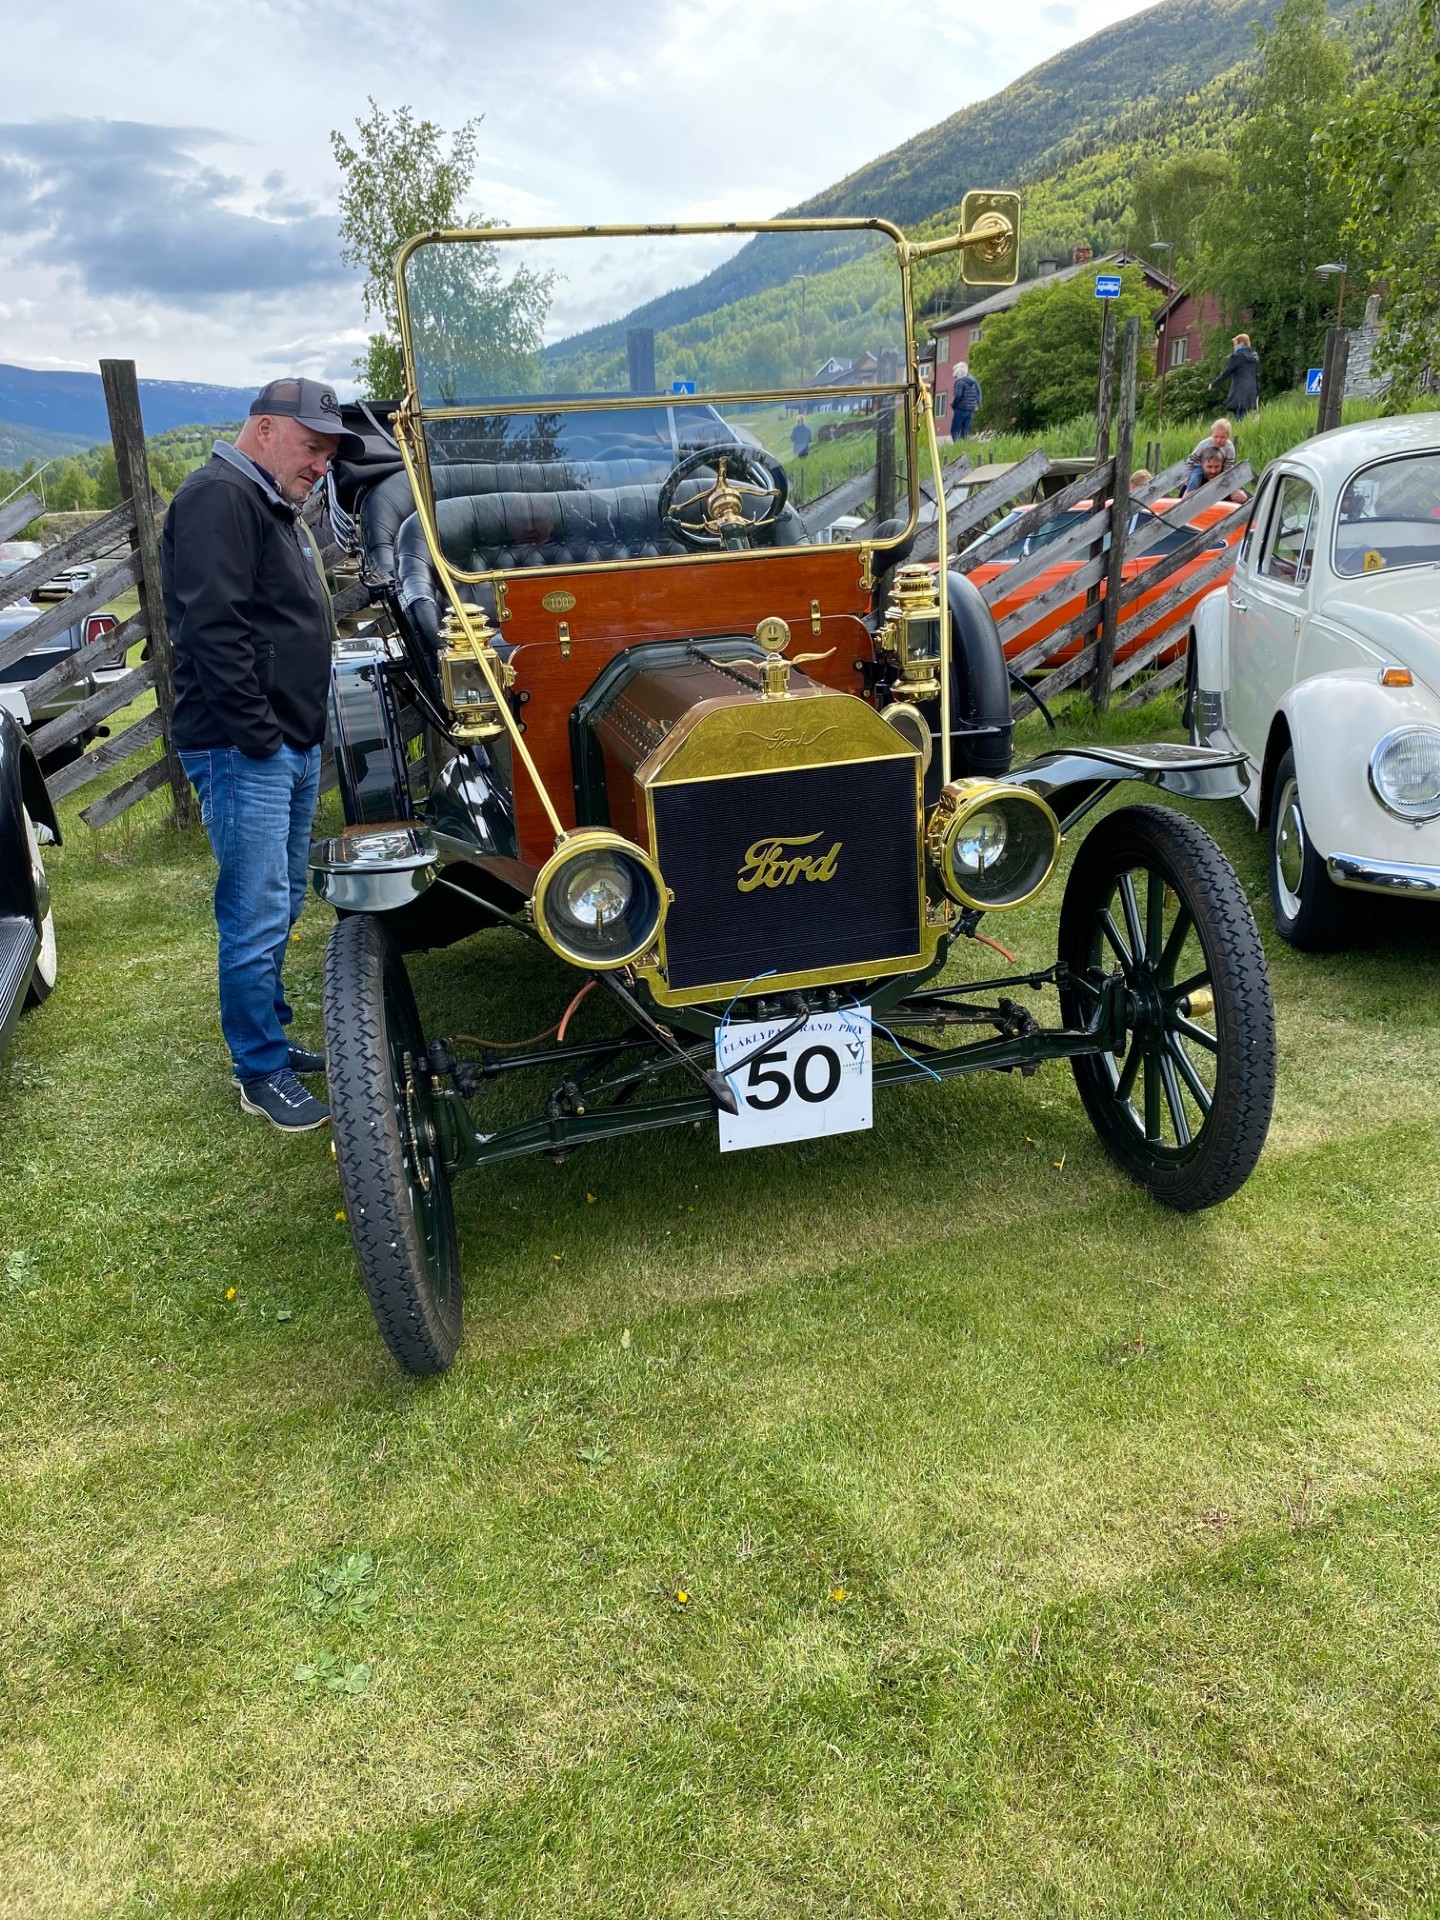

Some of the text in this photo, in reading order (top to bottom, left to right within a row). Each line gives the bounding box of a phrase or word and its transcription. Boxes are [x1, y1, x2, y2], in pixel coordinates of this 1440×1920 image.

[737, 830, 843, 893] Ford
[798, 1023, 832, 1032] RAND
[838, 1023, 865, 1035] PRIX
[745, 1045, 841, 1110] 50
